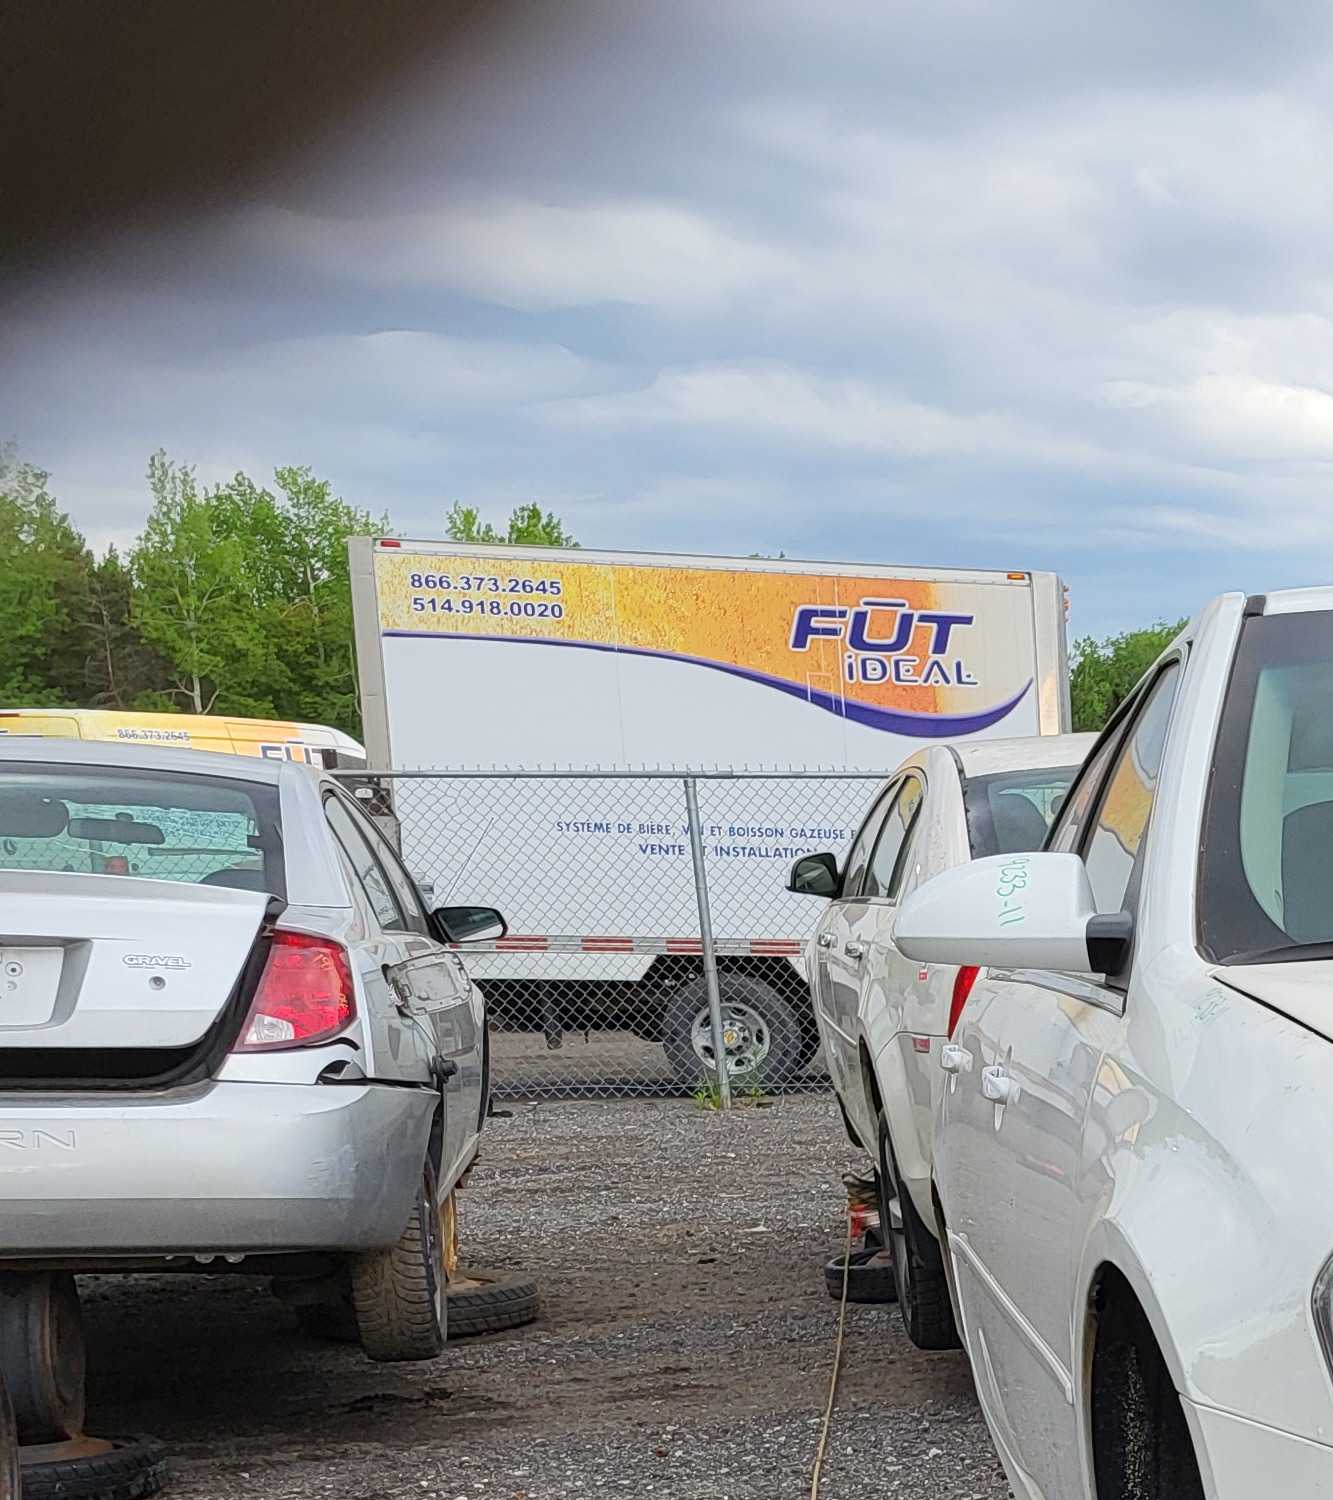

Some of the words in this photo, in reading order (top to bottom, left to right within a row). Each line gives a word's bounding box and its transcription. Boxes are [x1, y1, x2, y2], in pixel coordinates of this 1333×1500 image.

[410, 573, 562, 596] 866.373.2645
[412, 597, 563, 618] 514.918.0020
[618, 823, 633, 834] DE
[711, 825, 722, 836] ET
[728, 826, 785, 838] BOISSON
[790, 827, 846, 840] GAZEUSE
[638, 843, 686, 856] VENTE
